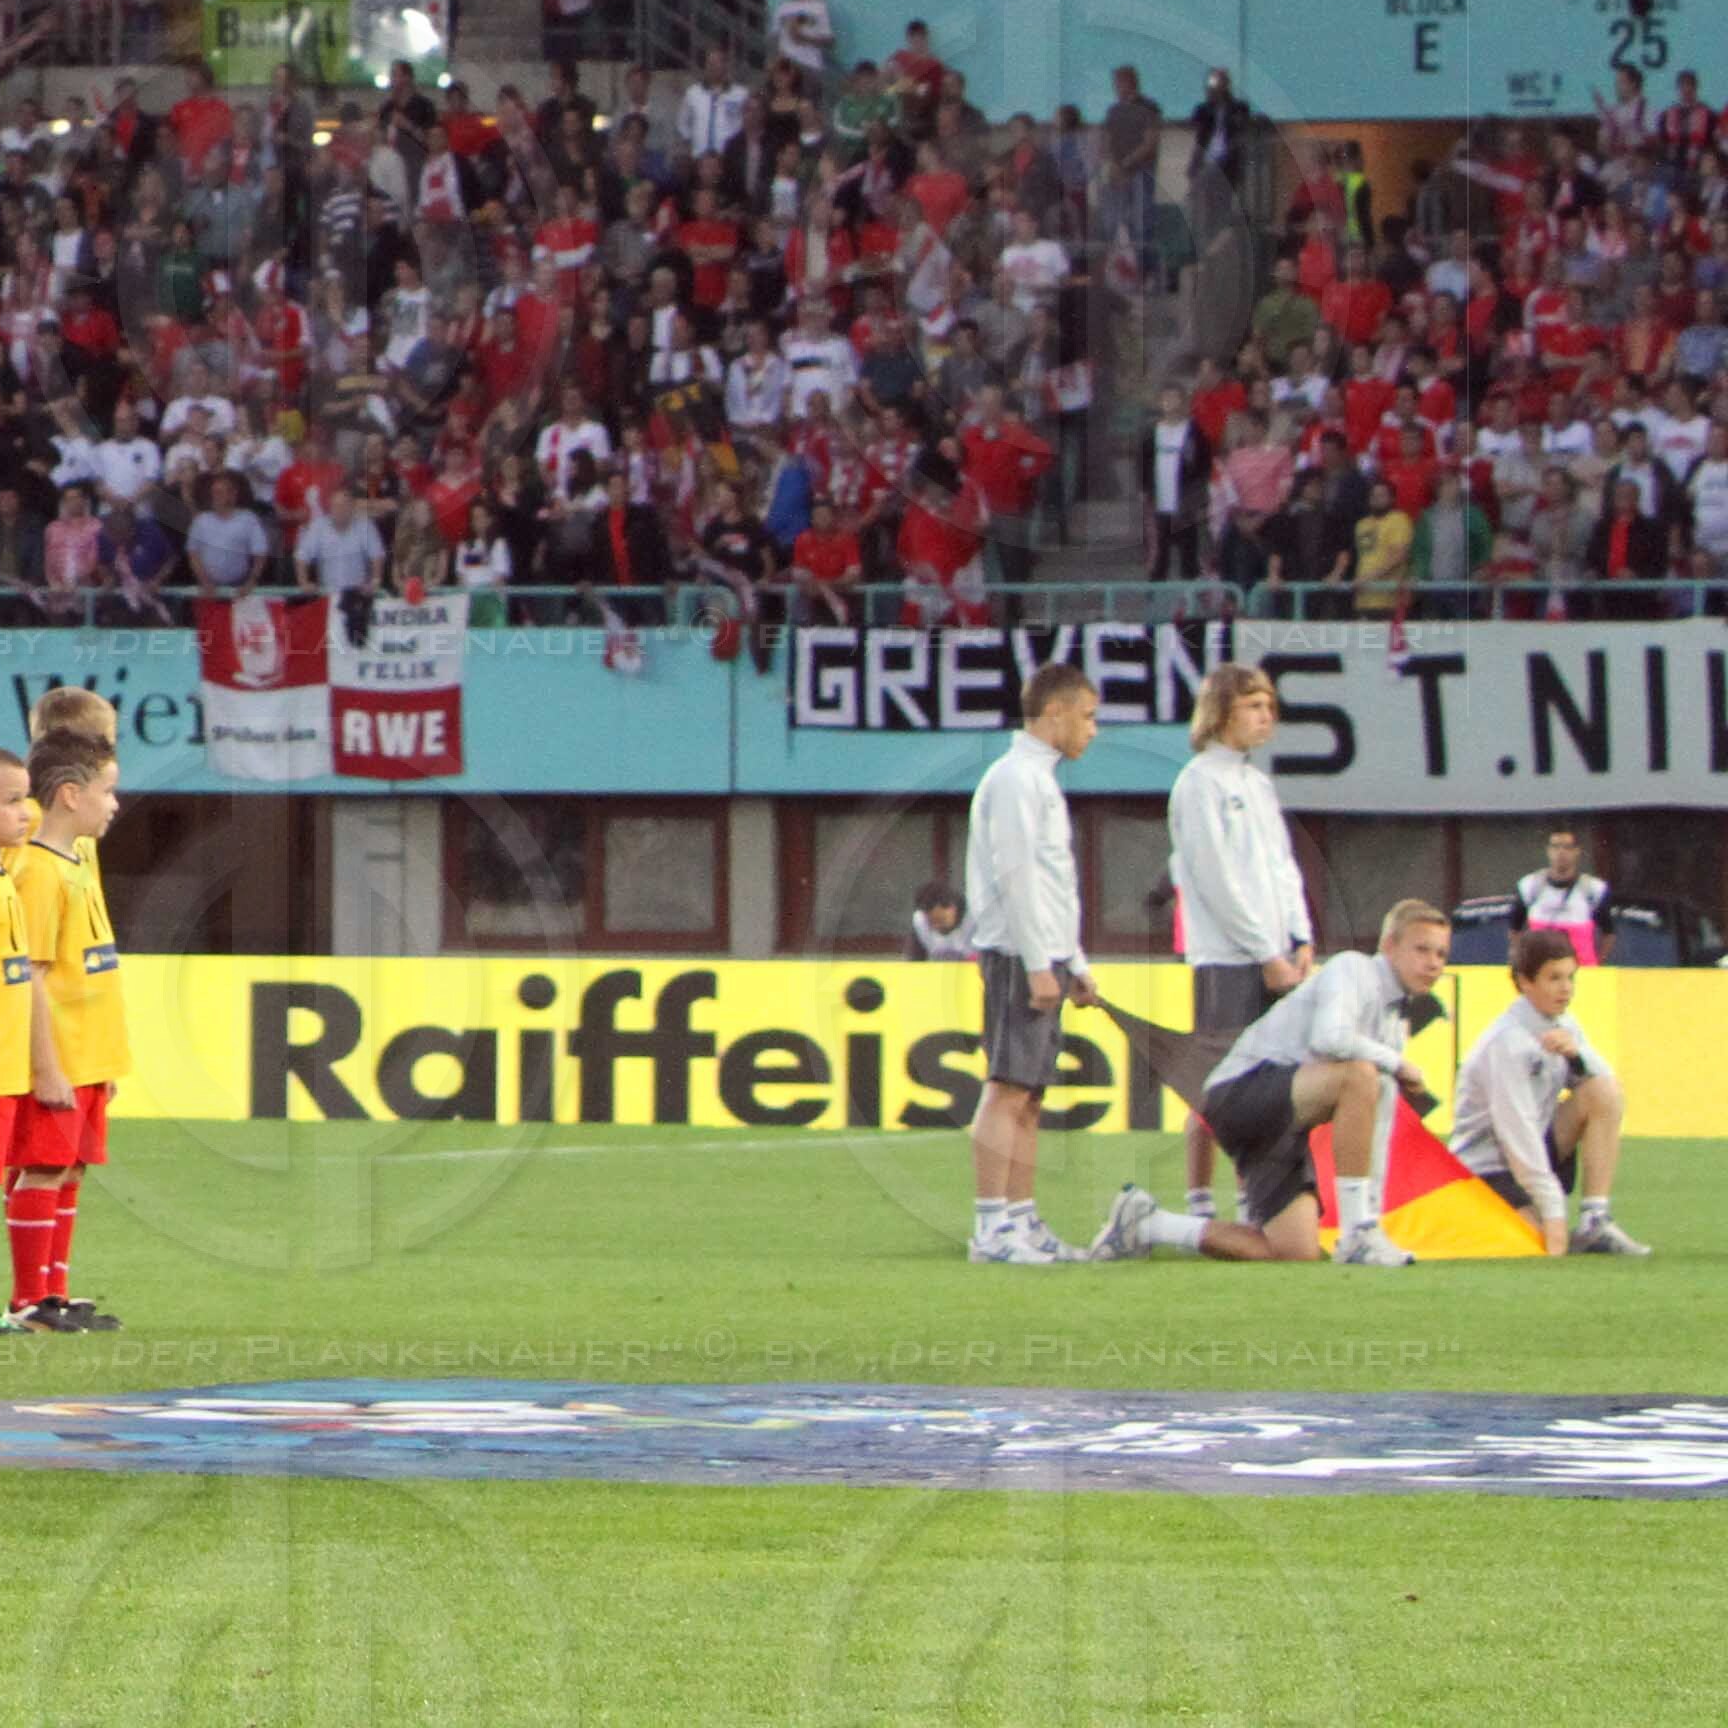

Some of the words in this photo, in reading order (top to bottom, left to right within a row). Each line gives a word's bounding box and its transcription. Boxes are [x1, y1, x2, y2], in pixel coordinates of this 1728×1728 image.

[1414, 22, 1442, 74] E
[1608, 20, 1670, 70] 25
[795, 620, 1224, 729] GREVEN
[342, 708, 449, 758] RWE
